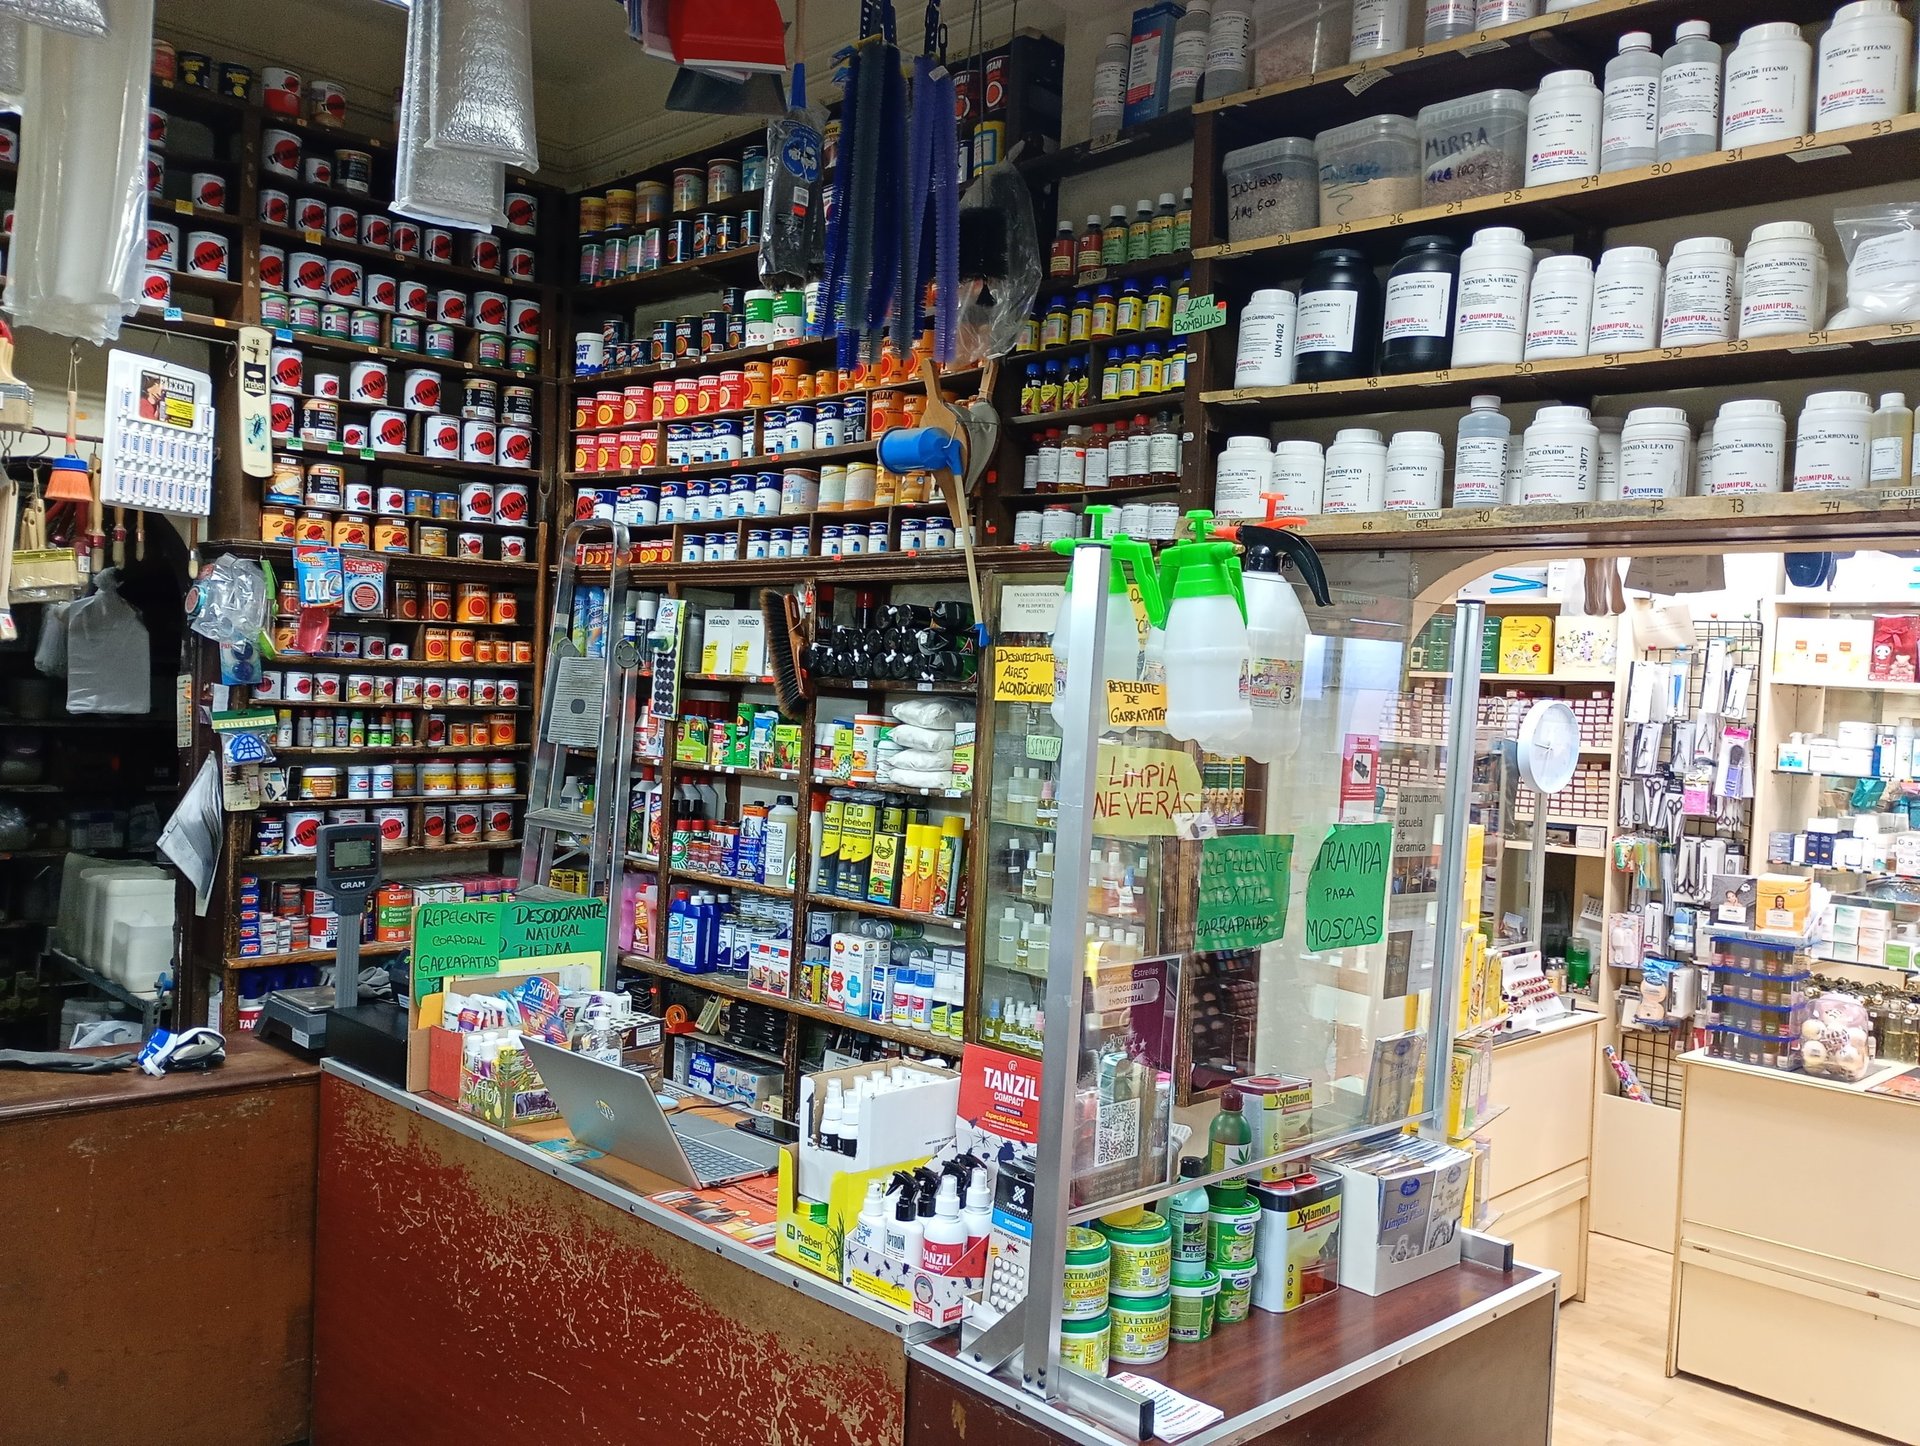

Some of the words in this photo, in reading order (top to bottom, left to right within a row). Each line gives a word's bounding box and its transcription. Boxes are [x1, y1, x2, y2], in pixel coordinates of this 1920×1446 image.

[1559, 12, 1569, 23] 7
[1480, 31, 1487, 42] 6
[1417, 47, 1424, 58] 5
[1360, 62, 1366, 72] 4
[1762, 65, 1789, 73] TITANIO
[1308, 75, 1314, 85] 3
[1665, 70, 1698, 82] BUTANOL
[1648, 82, 1656, 108] 1790
[1828, 87, 1870, 101] QUIMIPUR,
[1732, 107, 1769, 121] QUIMIPUR,
[1646, 112, 1655, 130] UN
[1872, 119, 1893, 135] 33
[1793, 134, 1816, 149] 32
[1541, 150, 1575, 159] QUIMIPUR,
[1726, 150, 1743, 162] 31
[1651, 163, 1672, 176] 30
[1581, 175, 1599, 190] 29
[1503, 190, 1523, 204] 28
[1257, 198, 1276, 212] 600
[1446, 201, 1463, 214] 27
[1390, 213, 1404, 225] 26
[1337, 223, 1352, 235] 25
[1278, 234, 1291, 246] 24
[1217, 244, 1232, 255] 23
[1725, 275, 1733, 297] 3077
[1188, 296, 1212, 312] LACA
[1752, 302, 1794, 311] QUIMIPUR,
[1469, 313, 1505, 321] QUIMIPUR,
[1724, 302, 1731, 321] UN
[1671, 315, 1708, 324] QUIMIPUR,
[1597, 322, 1632, 331] QUIMIPUR,
[1891, 324, 1912, 335] 55
[1532, 329, 1566, 338] QUIMIPUR,
[1808, 332, 1828, 344] 54
[1274, 323, 1285, 358] UN1402
[1727, 341, 1749, 352] 53
[1661, 347, 1682, 359] 52
[1604, 355, 1620, 365] 51
[1515, 362, 1533, 374] 50
[1435, 371, 1449, 381] 49
[1308, 383, 1320, 393] 47
[1366, 377, 1378, 388] 48
[1232, 389, 1244, 400] 46
[1641, 443, 1674, 451] SULFATO
[1579, 446, 1589, 471] 3077
[1578, 473, 1586, 490] UN
[1799, 473, 1836, 481] QUIMIPUR,
[1629, 487, 1664, 495] QUIMIPUR
[1716, 481, 1753, 489] QUIMIPUR,
[1881, 489, 1920, 498] TEGOBE
[1650, 500, 1664, 513] 72
[1728, 498, 1745, 513] 73
[1820, 501, 1840, 513] 74
[1408, 511, 1441, 520] METANOL
[1477, 511, 1490, 523] 70
[1572, 507, 1585, 518] 71
[1362, 522, 1373, 531] 68
[1415, 519, 1428, 529] 69
[1108, 681, 1160, 695] REPELENTE
[1284, 687, 1291, 700] 3
[1126, 694, 1139, 704] DE
[1110, 708, 1168, 724] GARRAPATA
[218, 718, 272, 728] COLLECTION
[1092, 791, 1195, 820] NEVERAS
[1399, 806, 1407, 815] tu
[1398, 817, 1423, 828] escuela
[1397, 830, 1406, 840] de
[1204, 848, 1285, 876] REPELENTE
[1315, 842, 1382, 875] TRAMPA
[340, 880, 366, 890] GRAM
[388, 893, 412, 901] Quimb
[1209, 884, 1272, 907] TEXTIL
[1325, 887, 1355, 901] PARA
[423, 909, 497, 928] REPELENTE
[513, 902, 608, 925] DESODORANTE
[1197, 914, 1270, 938] GARRAPATAS
[1306, 916, 1377, 945] MOSCAS
[525, 925, 586, 941] NATURAL
[432, 935, 486, 946] CORPORAL
[516, 941, 572, 957] PIEDRA
[418, 954, 498, 973] GARRAPATAS
[872, 990, 884, 1002] ZZ
[239, 1019, 257, 1029] TAN
[994, 1091, 1025, 1108] COMPACT
[1274, 1091, 1311, 1107] Xylamon
[1006, 1117, 1029, 1129] chinches
[1297, 1203, 1331, 1222] Xylamon
[797, 1230, 823, 1250] Preben
[1063, 1280, 1093, 1288] RCILLA
